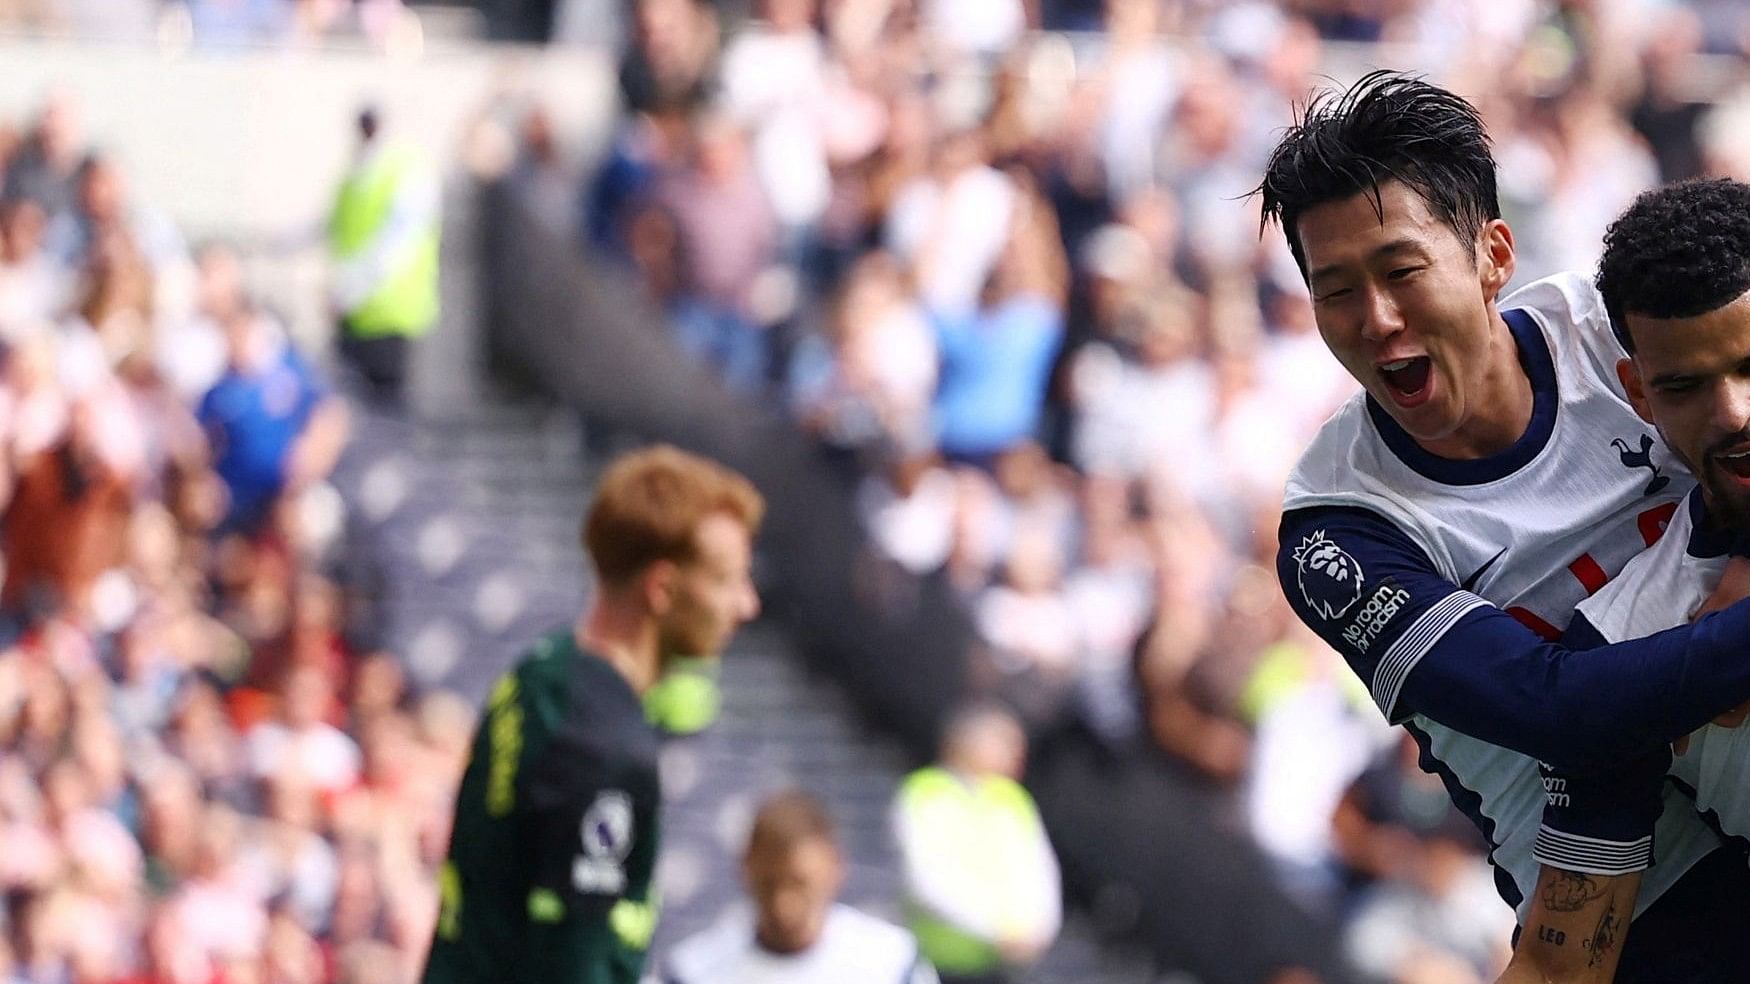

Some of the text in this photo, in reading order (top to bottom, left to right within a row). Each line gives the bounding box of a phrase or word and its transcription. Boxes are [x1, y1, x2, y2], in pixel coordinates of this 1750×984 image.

[1341, 585, 1394, 647] No room
[1366, 588, 1411, 640] racism
[1537, 924, 1567, 946] LEO
